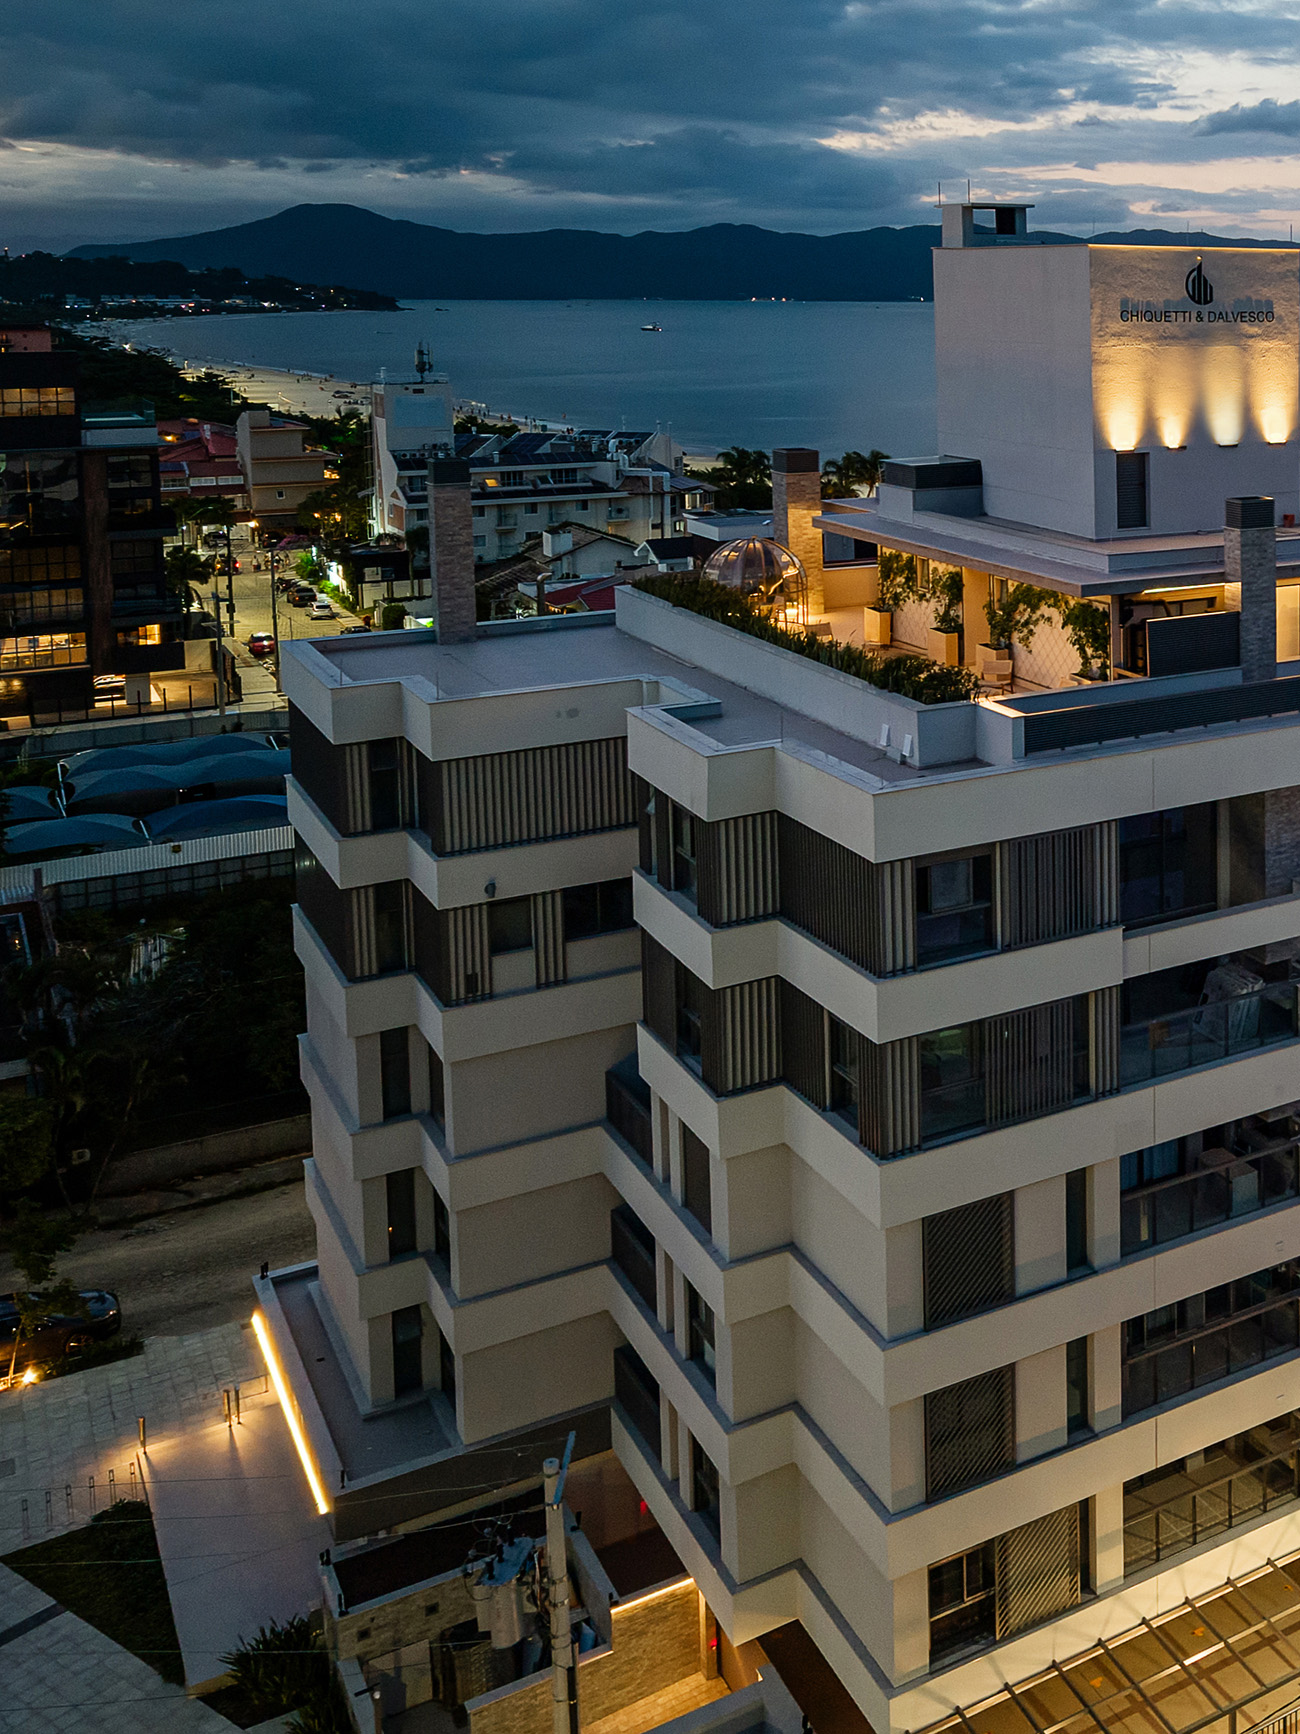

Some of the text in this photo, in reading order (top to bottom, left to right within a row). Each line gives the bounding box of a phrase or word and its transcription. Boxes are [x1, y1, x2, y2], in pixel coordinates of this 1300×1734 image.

[1120, 310, 1275, 323] CHIQUETTI & DALVESCO
